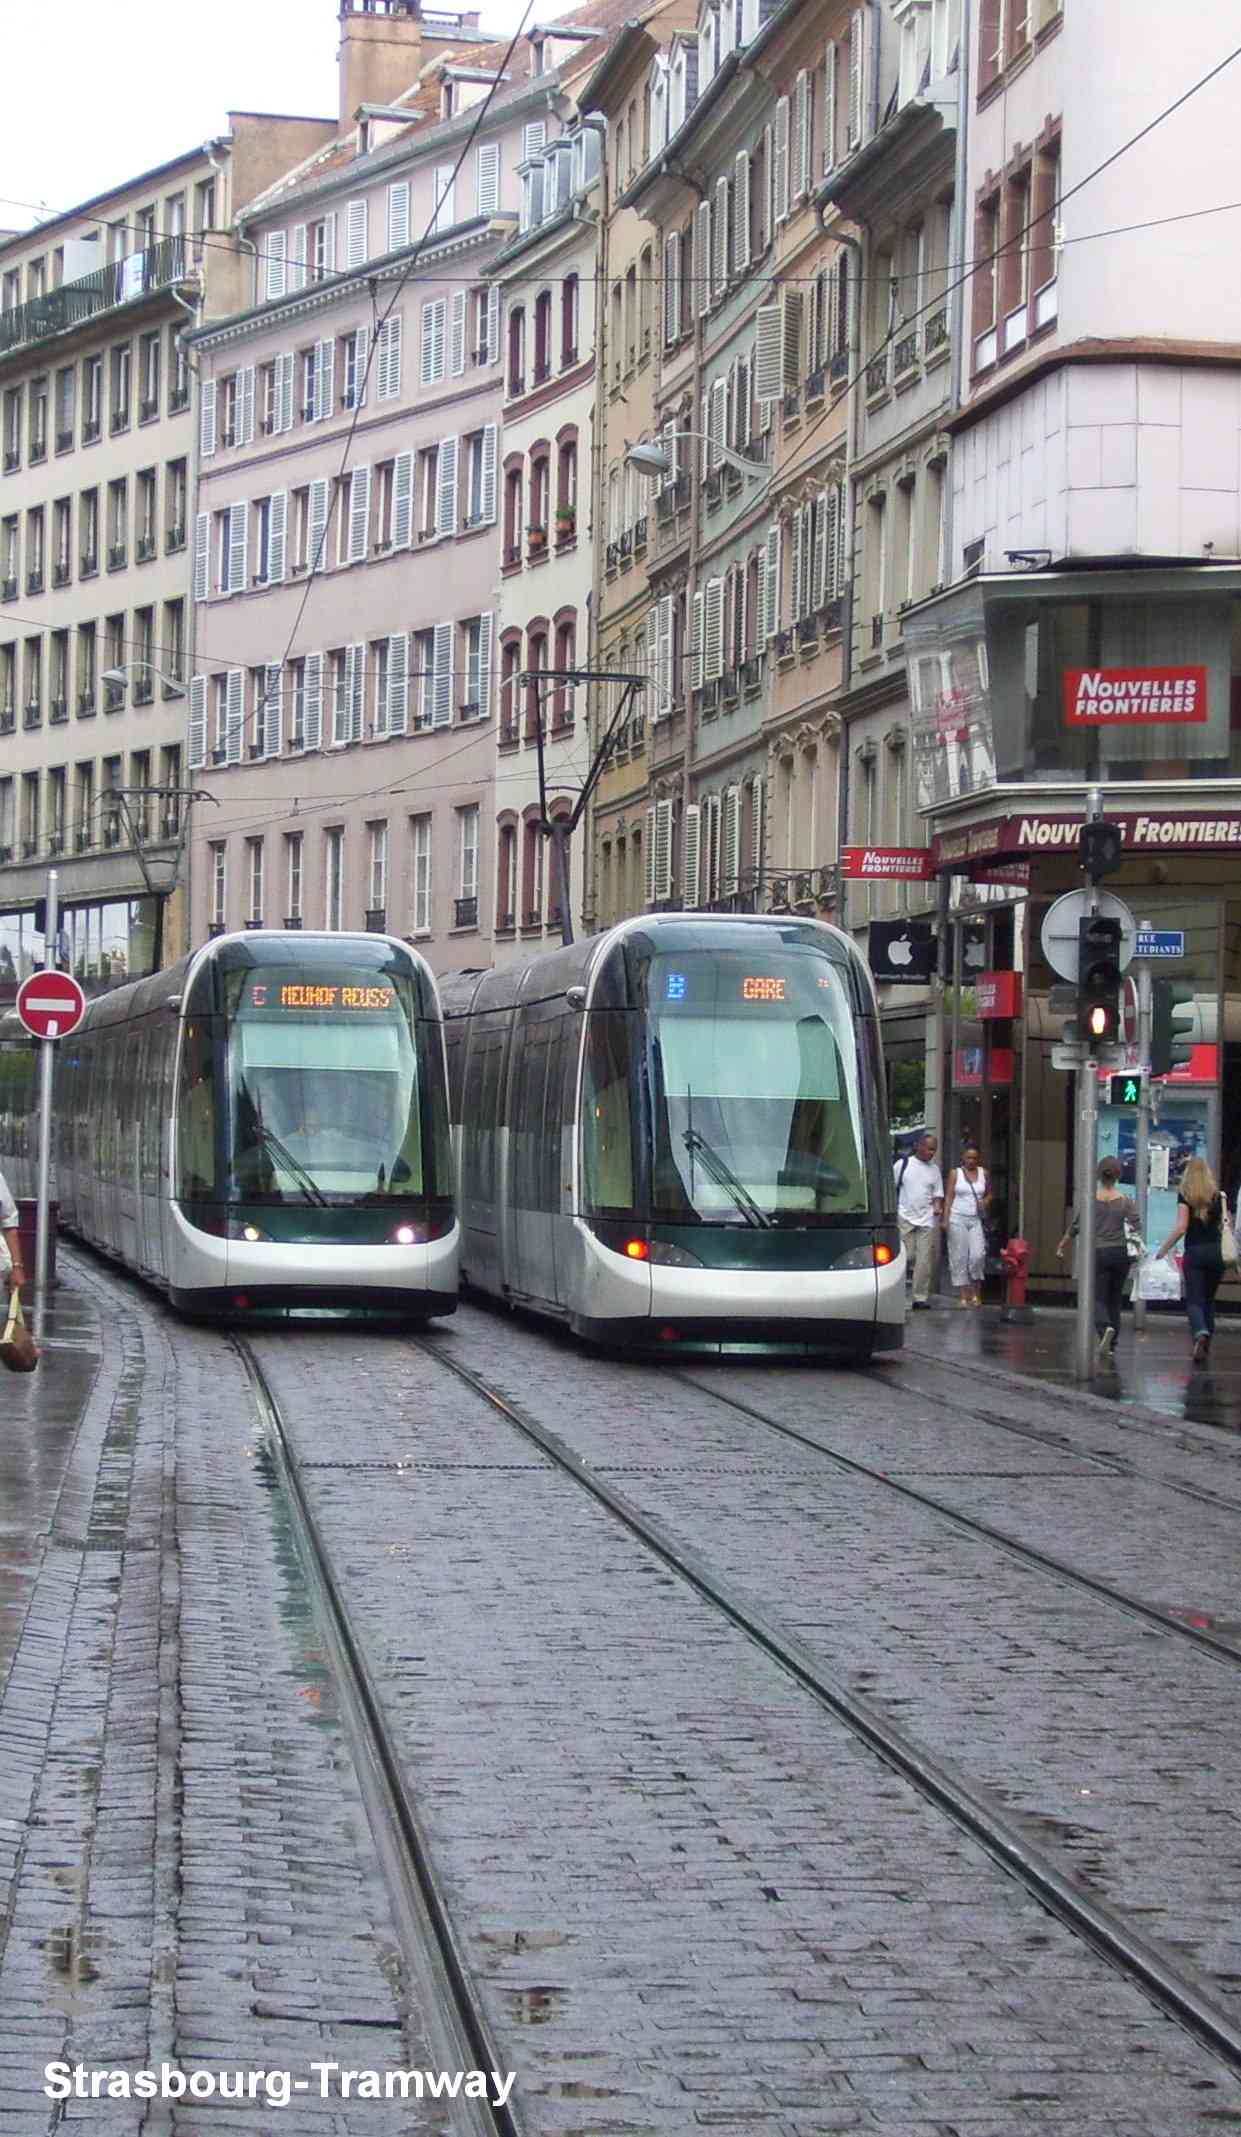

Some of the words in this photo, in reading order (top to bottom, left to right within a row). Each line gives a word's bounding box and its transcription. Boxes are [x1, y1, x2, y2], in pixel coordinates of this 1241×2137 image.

[1076, 672, 1197, 698] NOUVELLES
[1074, 696, 1195, 716] FRONTIERES
[1133, 816, 1241, 843] FRONTIERE
[1136, 945, 1181, 954] TUDIANTS
[742, 977, 786, 1000] GARE
